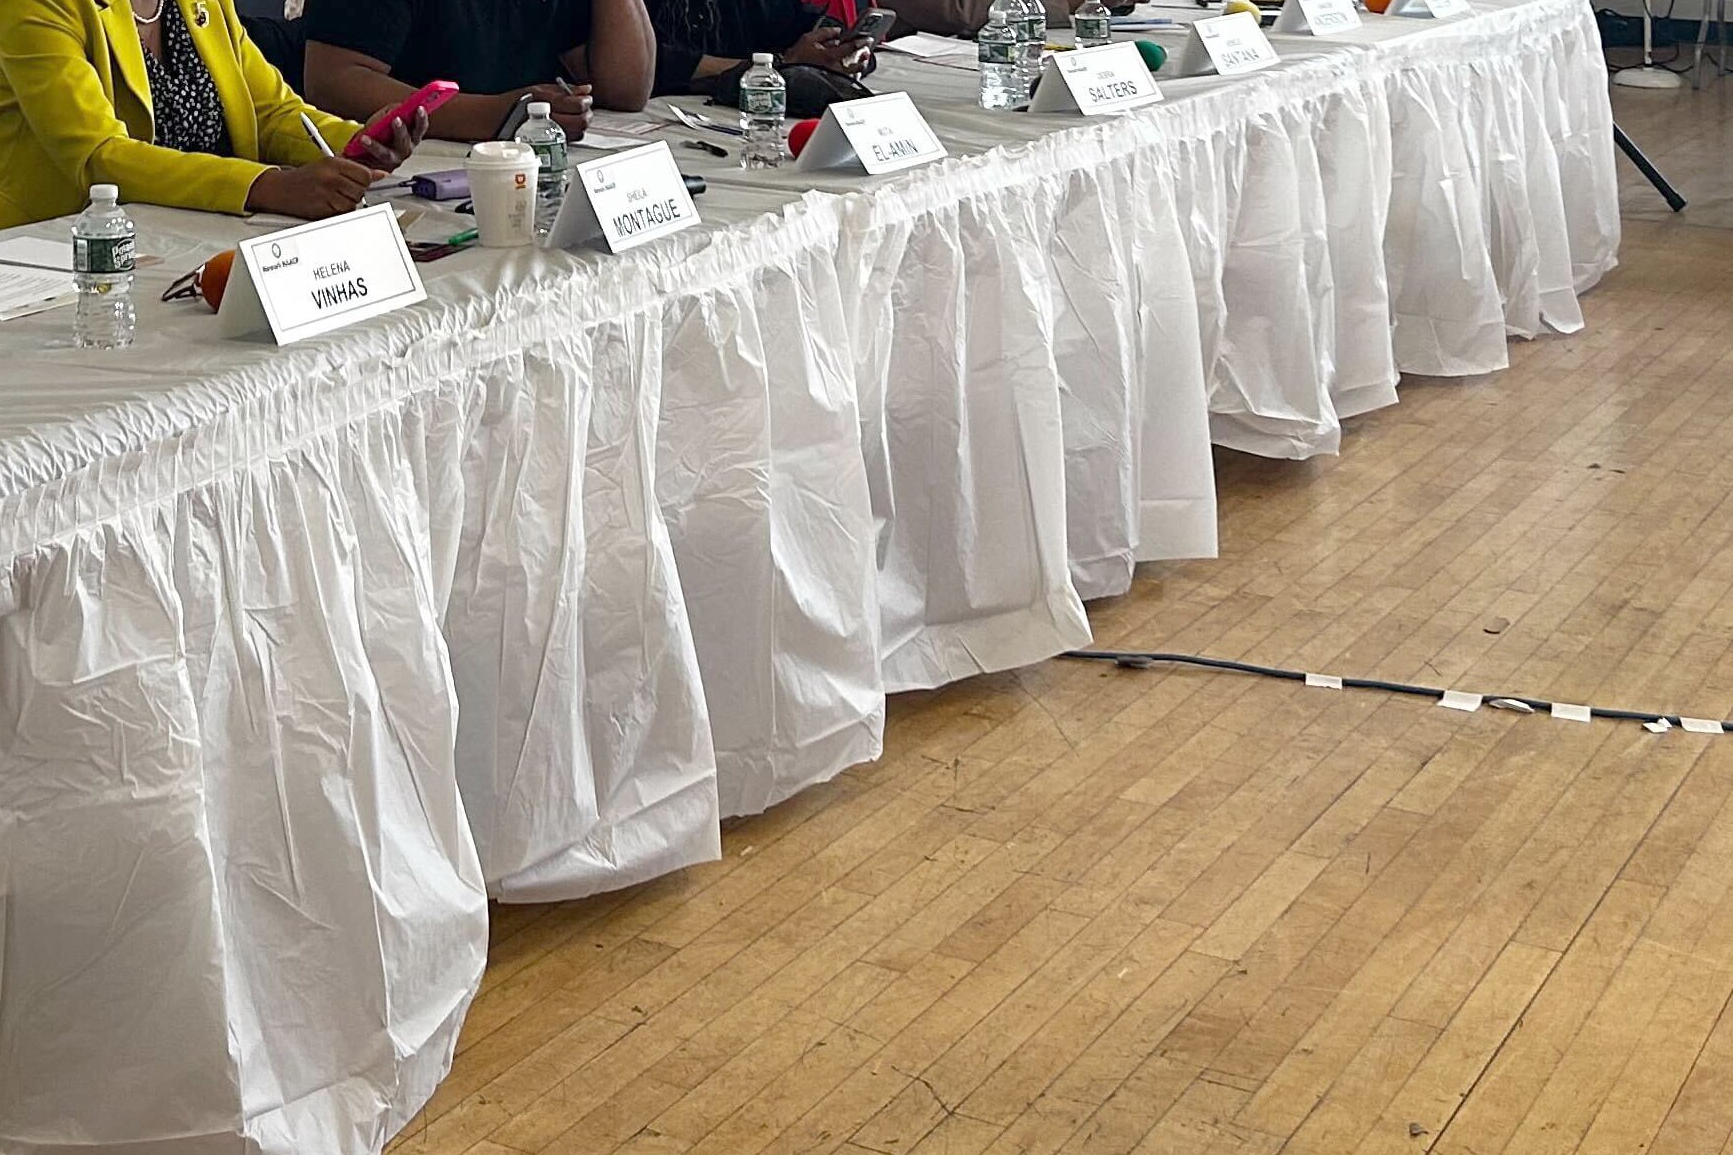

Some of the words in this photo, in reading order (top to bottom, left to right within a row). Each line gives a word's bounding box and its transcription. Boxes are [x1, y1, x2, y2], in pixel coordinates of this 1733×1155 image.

[1088, 80, 1138, 102] SALTERS
[872, 139, 919, 162] EL-AMIN
[612, 198, 681, 237] MONTAGUE
[313, 260, 350, 280] HELENA
[311, 277, 368, 310] VINHAS
